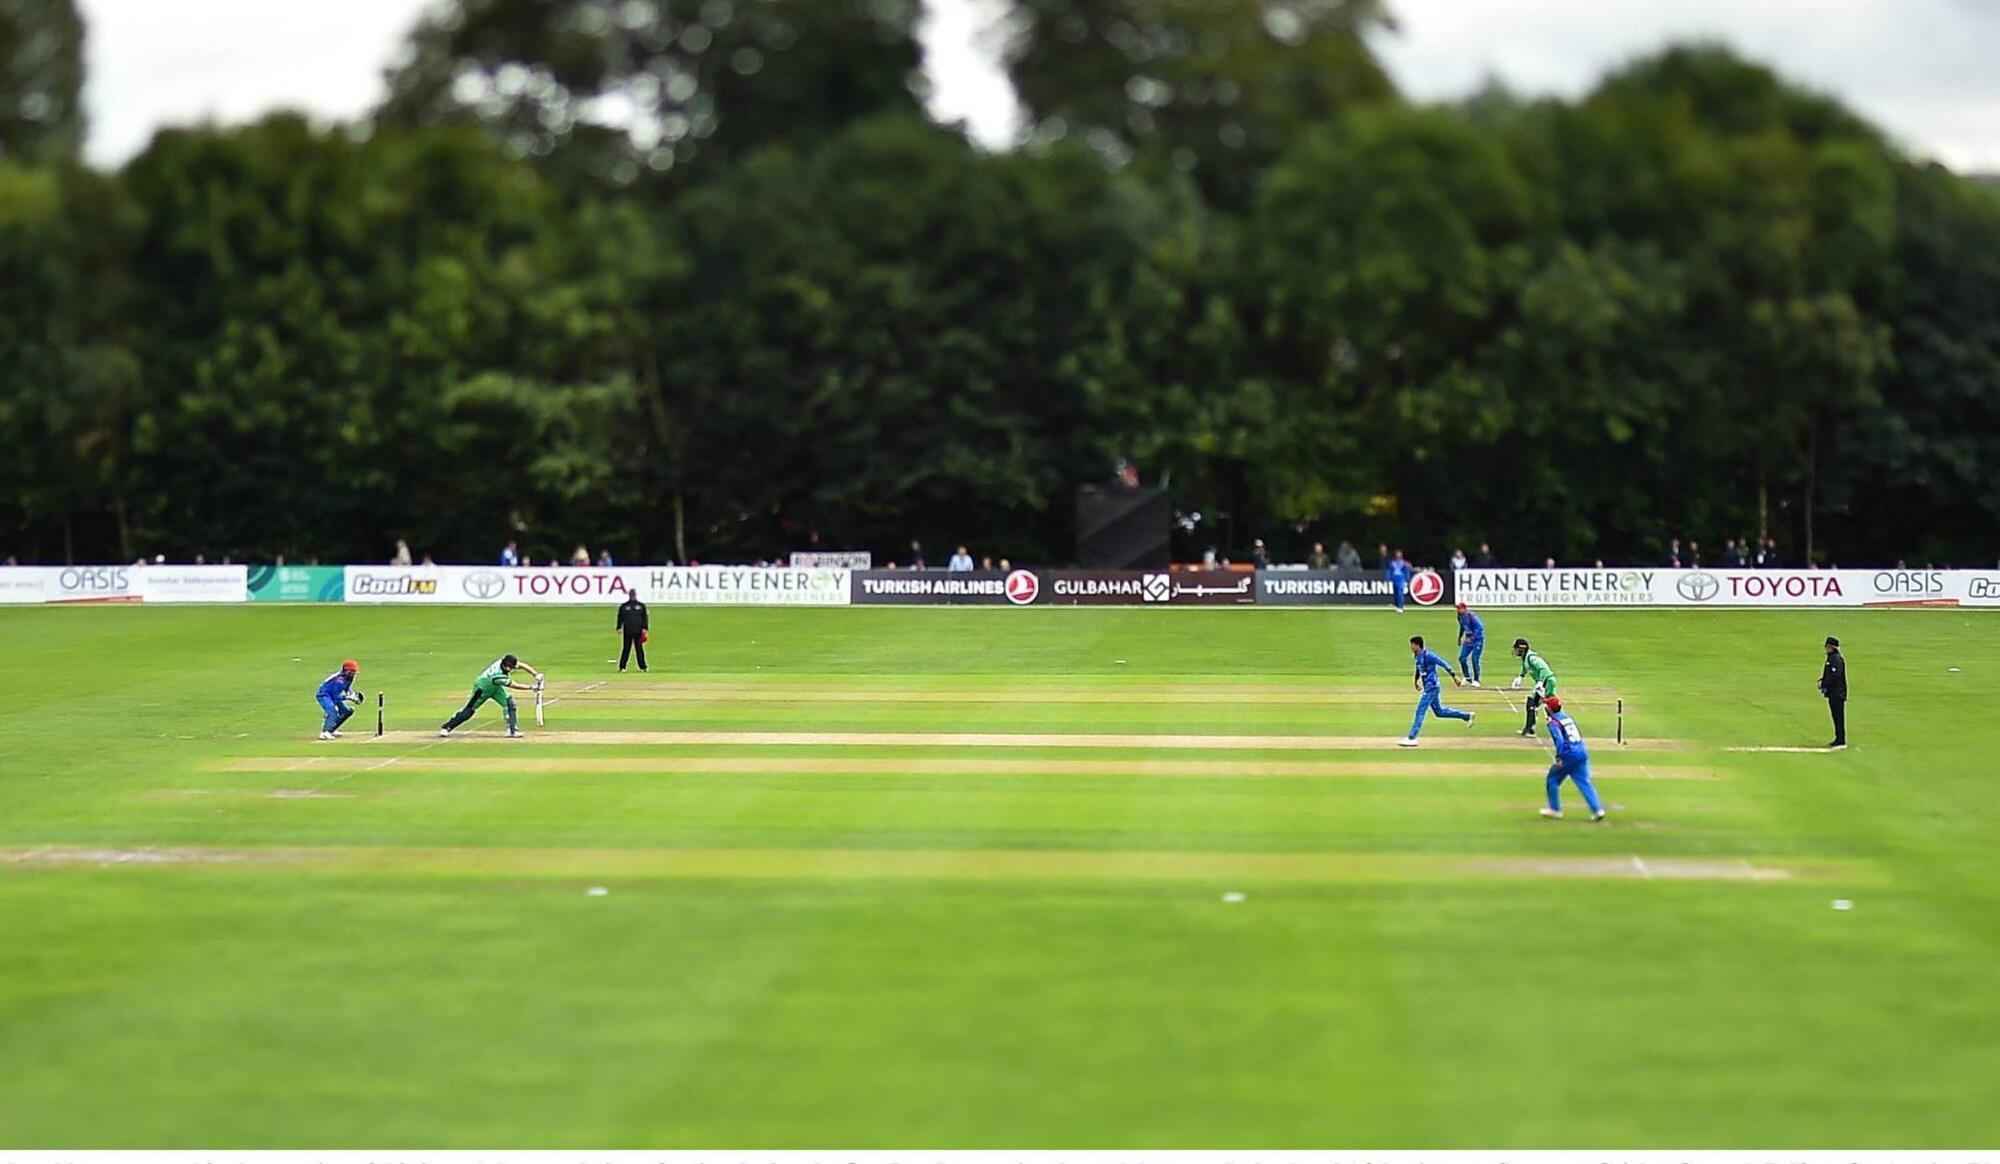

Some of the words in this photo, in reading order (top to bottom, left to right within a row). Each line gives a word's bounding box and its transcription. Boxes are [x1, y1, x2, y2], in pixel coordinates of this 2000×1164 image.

[60, 569, 129, 590] OASIS
[513, 575, 628, 595] TOYOTA
[651, 572, 744, 590] HANLEY
[863, 580, 933, 594] TURKISH
[934, 580, 1004, 594] AIRLINES
[1053, 580, 1142, 595] GULBAHAR
[1264, 580, 1336, 594] TURKISH
[1459, 572, 1552, 591] HANLEY
[1560, 571, 1654, 591] ENERGY
[1727, 576, 1843, 597] TOYOTA
[1873, 572, 1943, 592] OASIS
[1459, 593, 1516, 603] TRUSTED
[1525, 593, 1579, 603] ENERGY
[1586, 593, 1654, 603] PARTNERS
